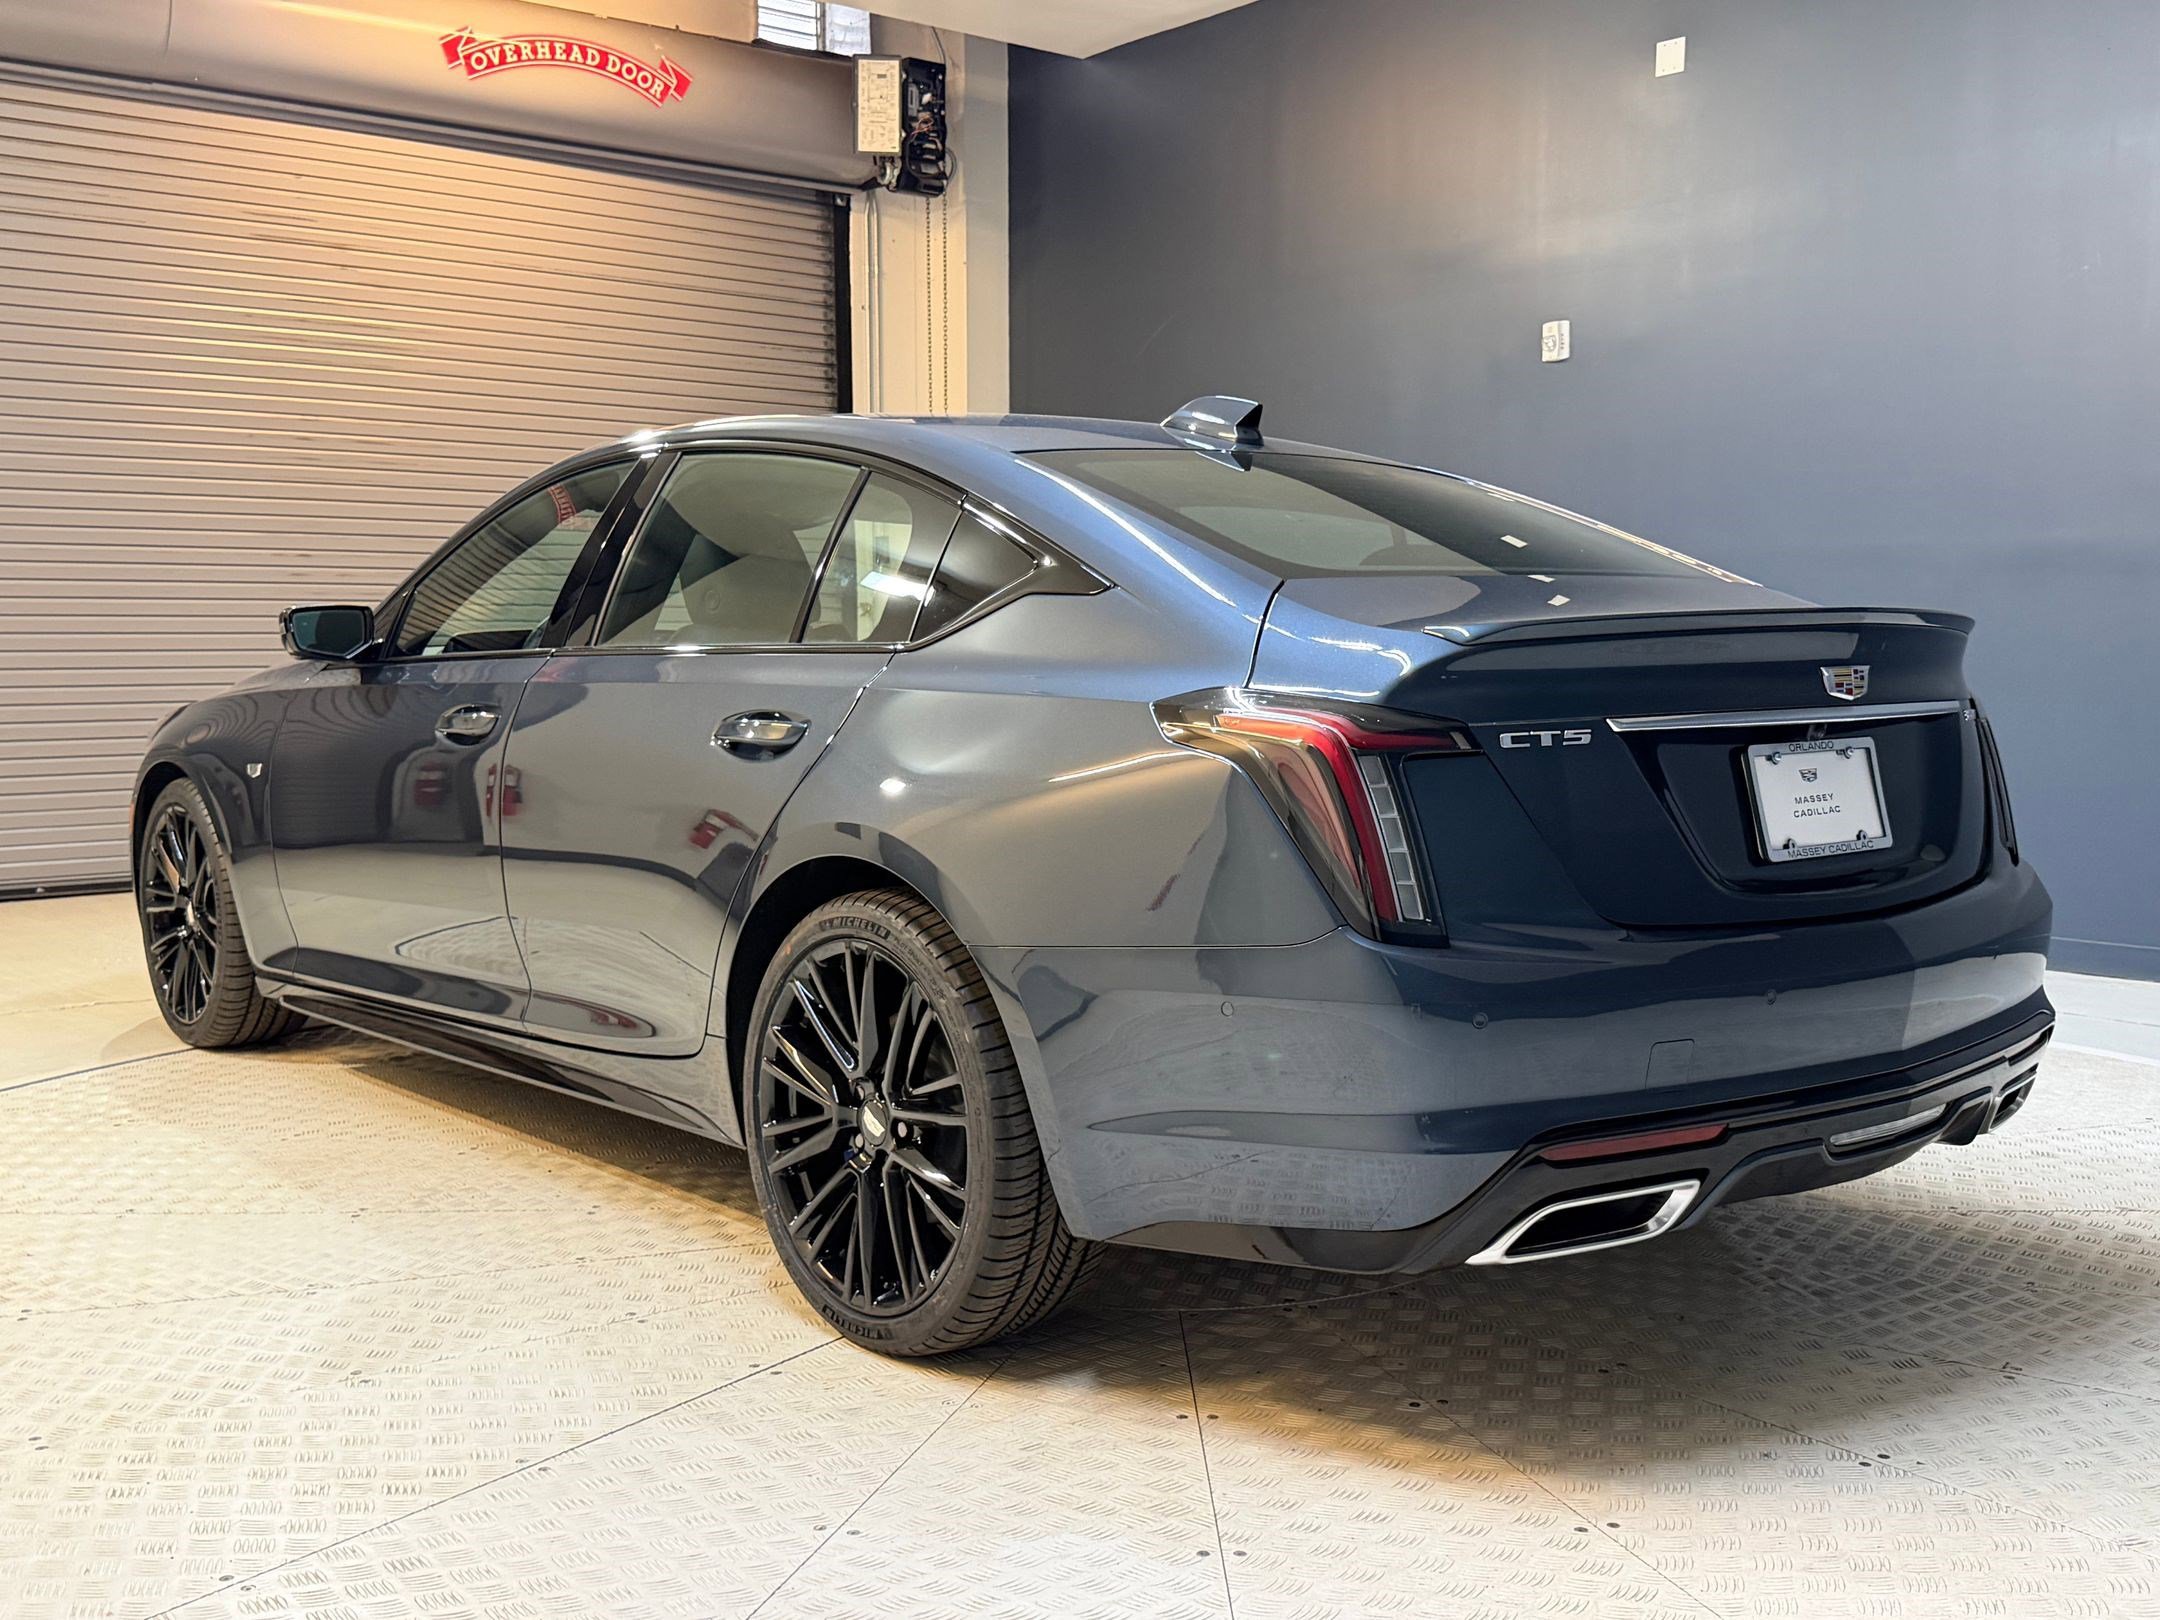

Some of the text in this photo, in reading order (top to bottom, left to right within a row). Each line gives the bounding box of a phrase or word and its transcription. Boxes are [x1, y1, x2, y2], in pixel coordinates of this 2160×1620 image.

[470, 41, 665, 100] OVERHEAD DOOR
[1499, 729, 1592, 748] CT5
[1788, 740, 1835, 752] ORLANDO
[1794, 793, 1834, 805] MASSEY
[1793, 805, 1841, 818] CADILLAC
[1787, 840, 1874, 859] MASSEY CADILLAC
[831, 917, 888, 939] MICHELIN
